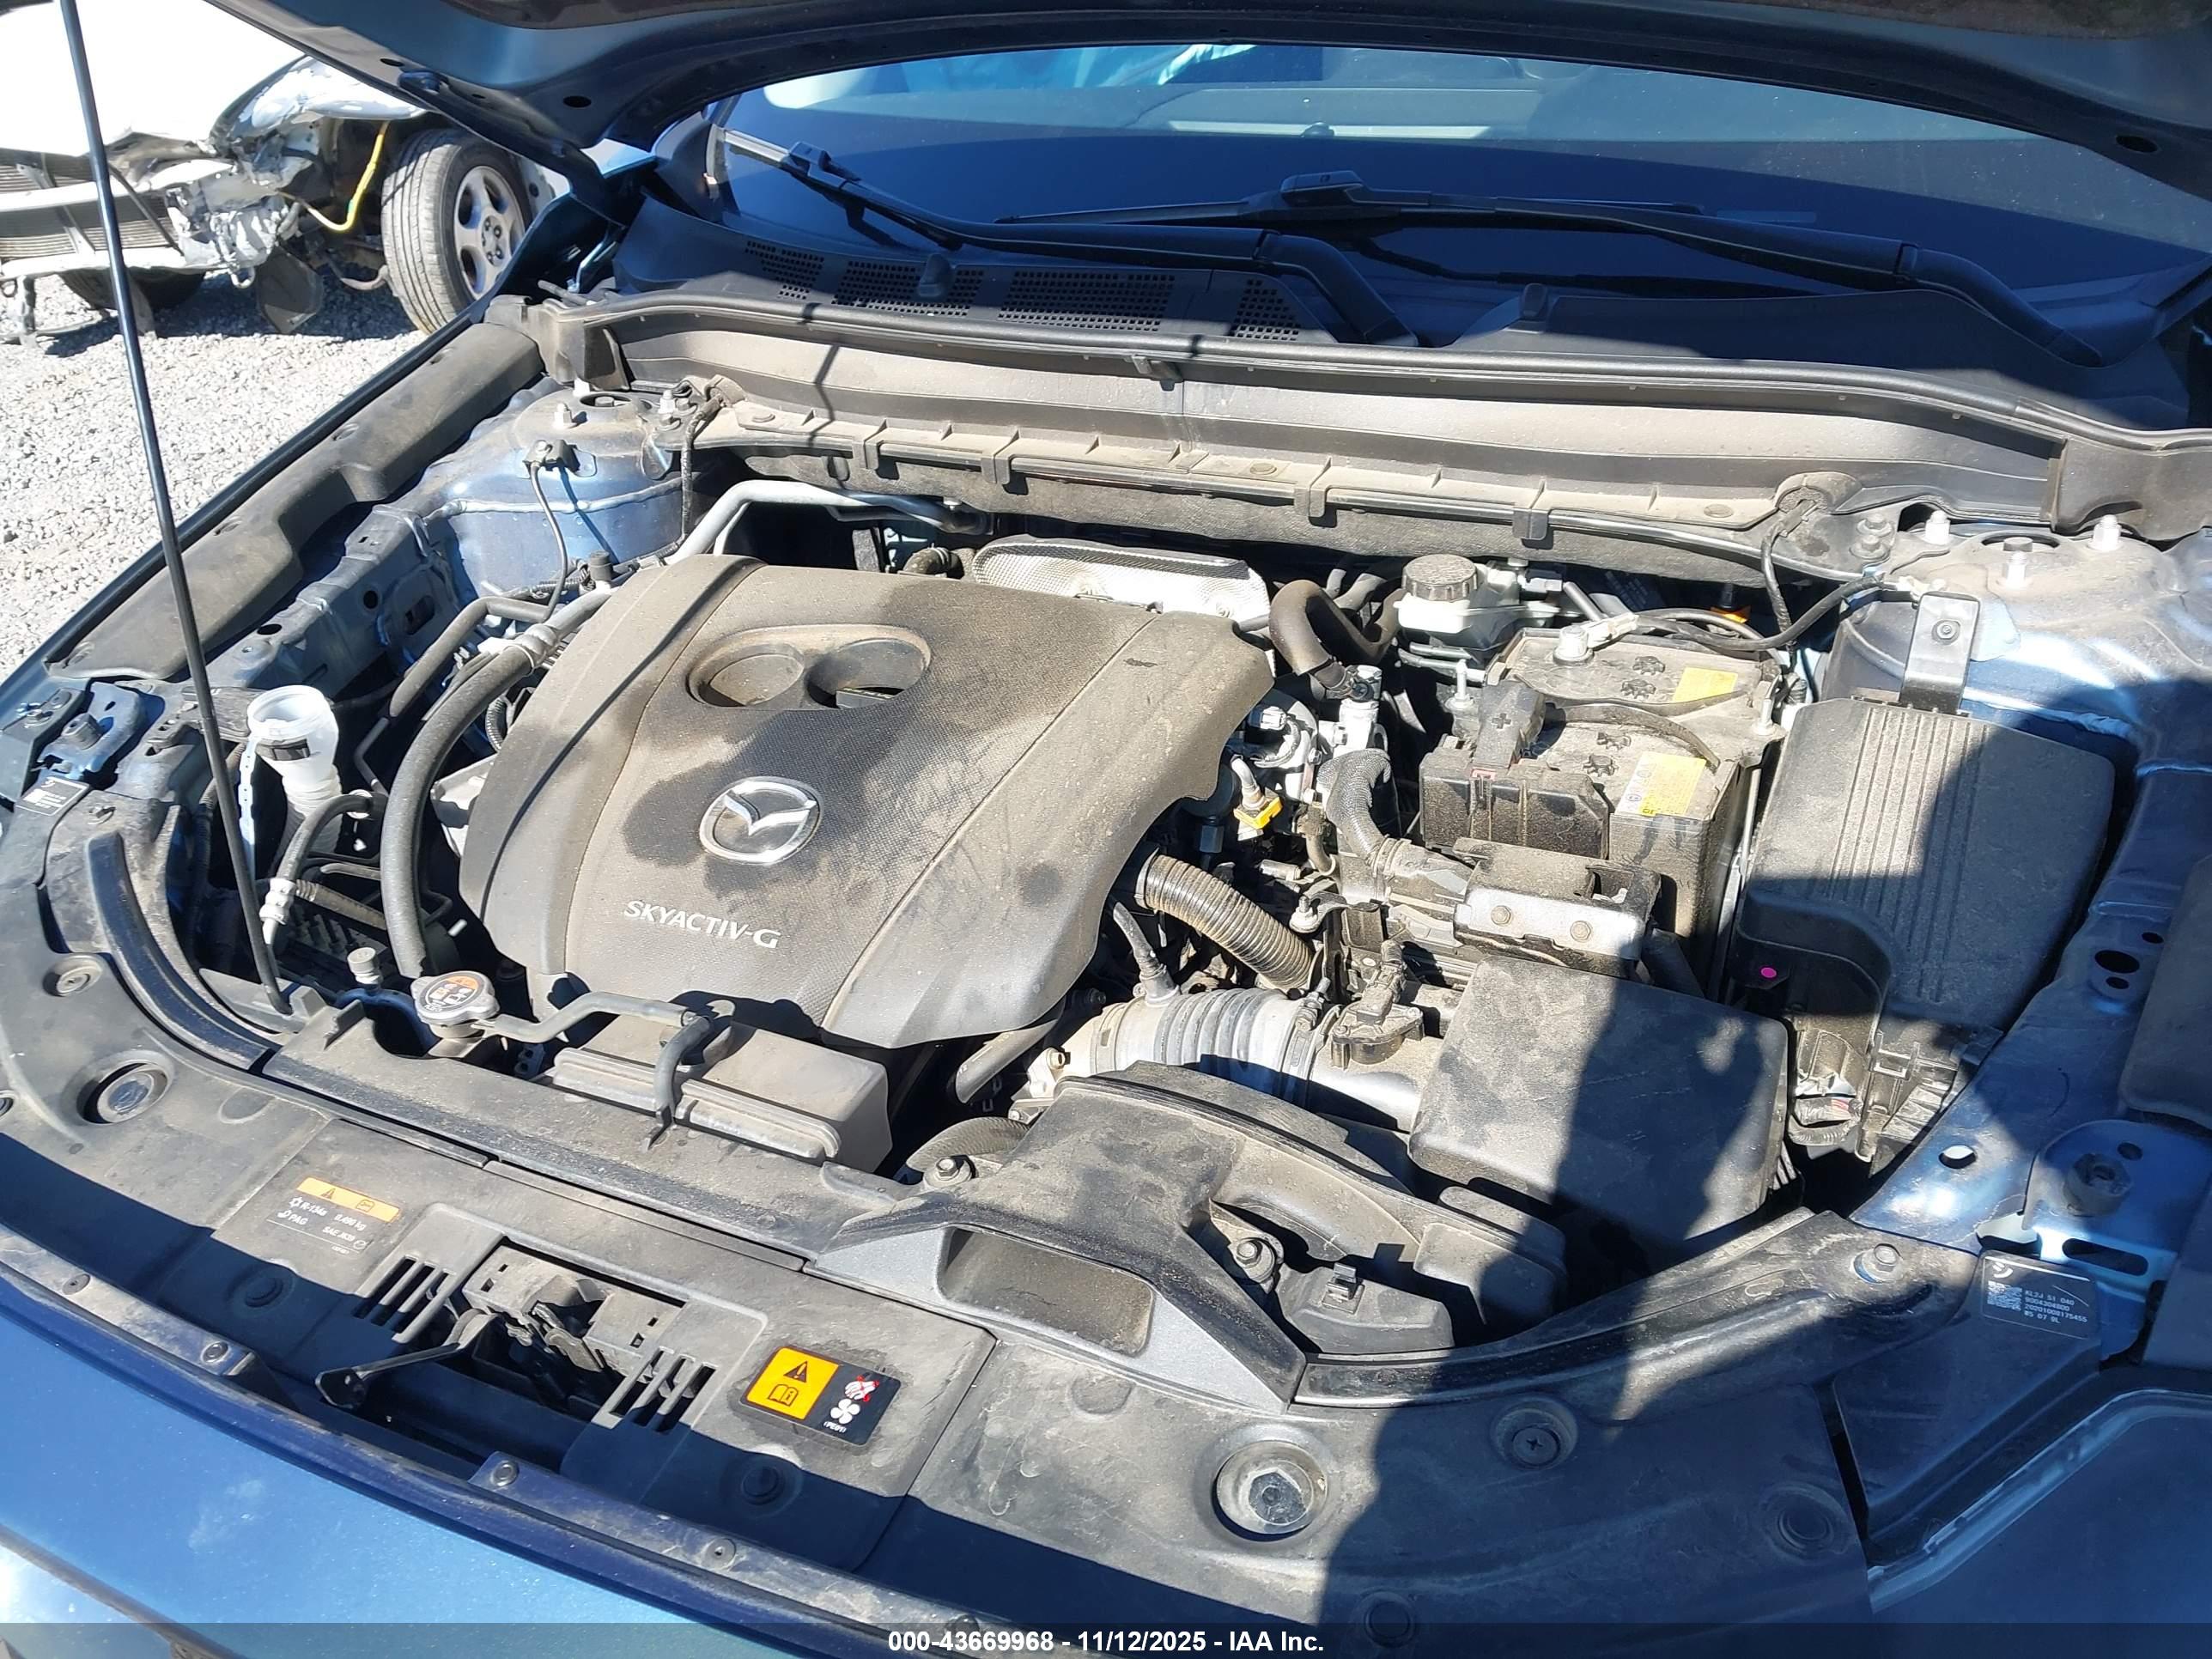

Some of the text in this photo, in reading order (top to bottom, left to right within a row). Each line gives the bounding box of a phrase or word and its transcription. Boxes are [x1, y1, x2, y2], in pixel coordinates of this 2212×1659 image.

[624, 900, 781, 949] SKYACTIV-G
[288, 1213, 309, 1225] PAG
[322, 1226, 342, 1237] SAE
